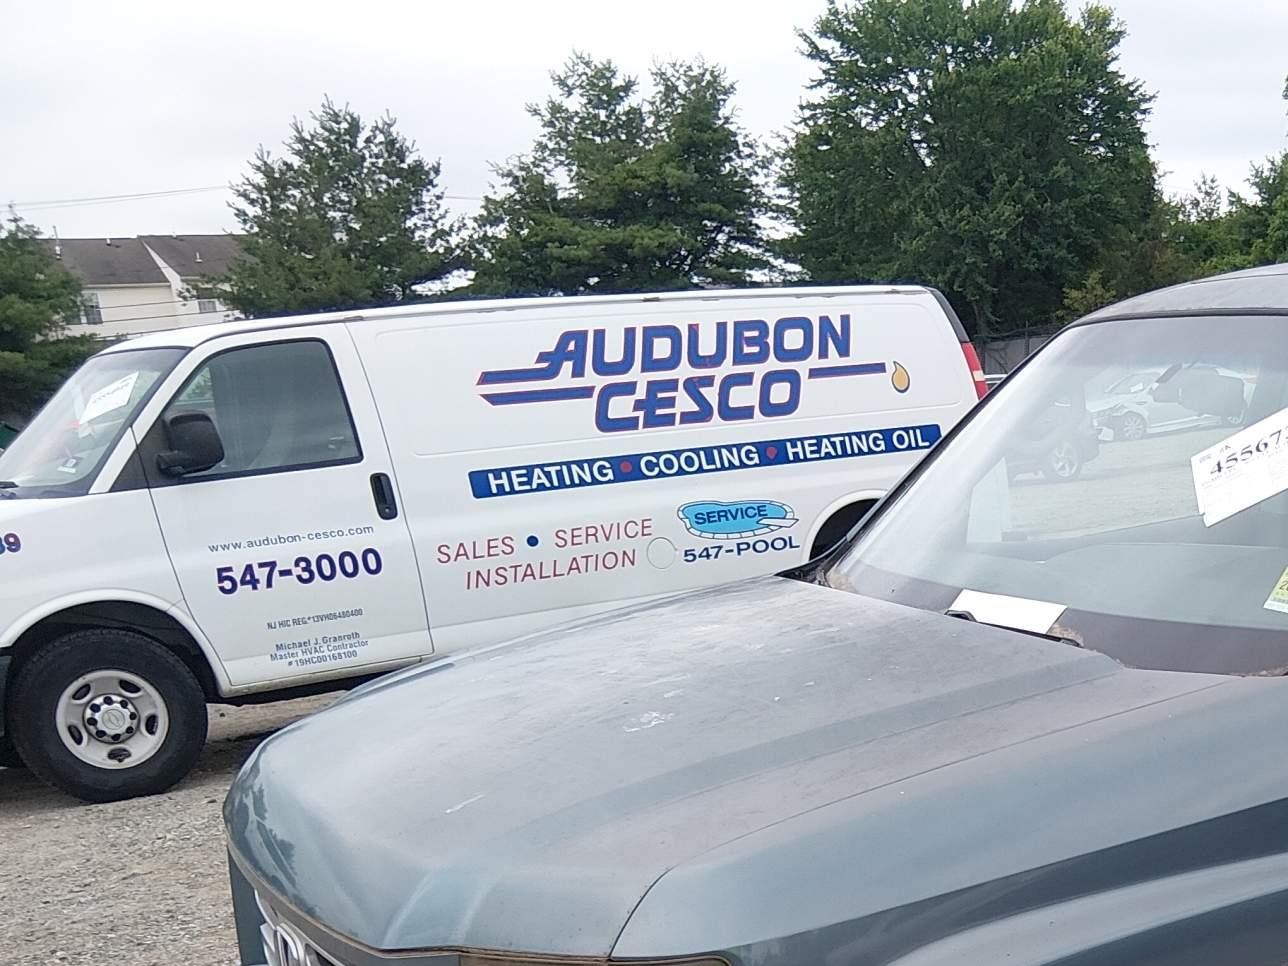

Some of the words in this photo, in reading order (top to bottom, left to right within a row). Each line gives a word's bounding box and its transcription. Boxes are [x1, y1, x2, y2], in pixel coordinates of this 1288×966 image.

[534, 314, 851, 380] AUDUBON
[594, 368, 801, 433] CESCO
[488, 461, 613, 495] HEATING
[640, 446, 759, 477] COOLING
[786, 433, 886, 462] HEATING
[892, 429, 930, 448] OIL
[693, 504, 769, 526] SERVICE
[208, 525, 374, 552] www.audubon-cesco.com
[437, 536, 515, 564] SALES
[554, 518, 653, 549] SERVICE
[683, 535, 801, 564] 547-POOL
[216, 547, 383, 595] 547-3000
[465, 549, 636, 590] INSTALLATION
[270, 651, 299, 662] Master
[301, 645, 325, 656] HVAC
[326, 639, 369, 652] Contractor
[275, 639, 311, 652] Michael
[313, 637, 321, 646] J.
[321, 632, 360, 644] Granroth
